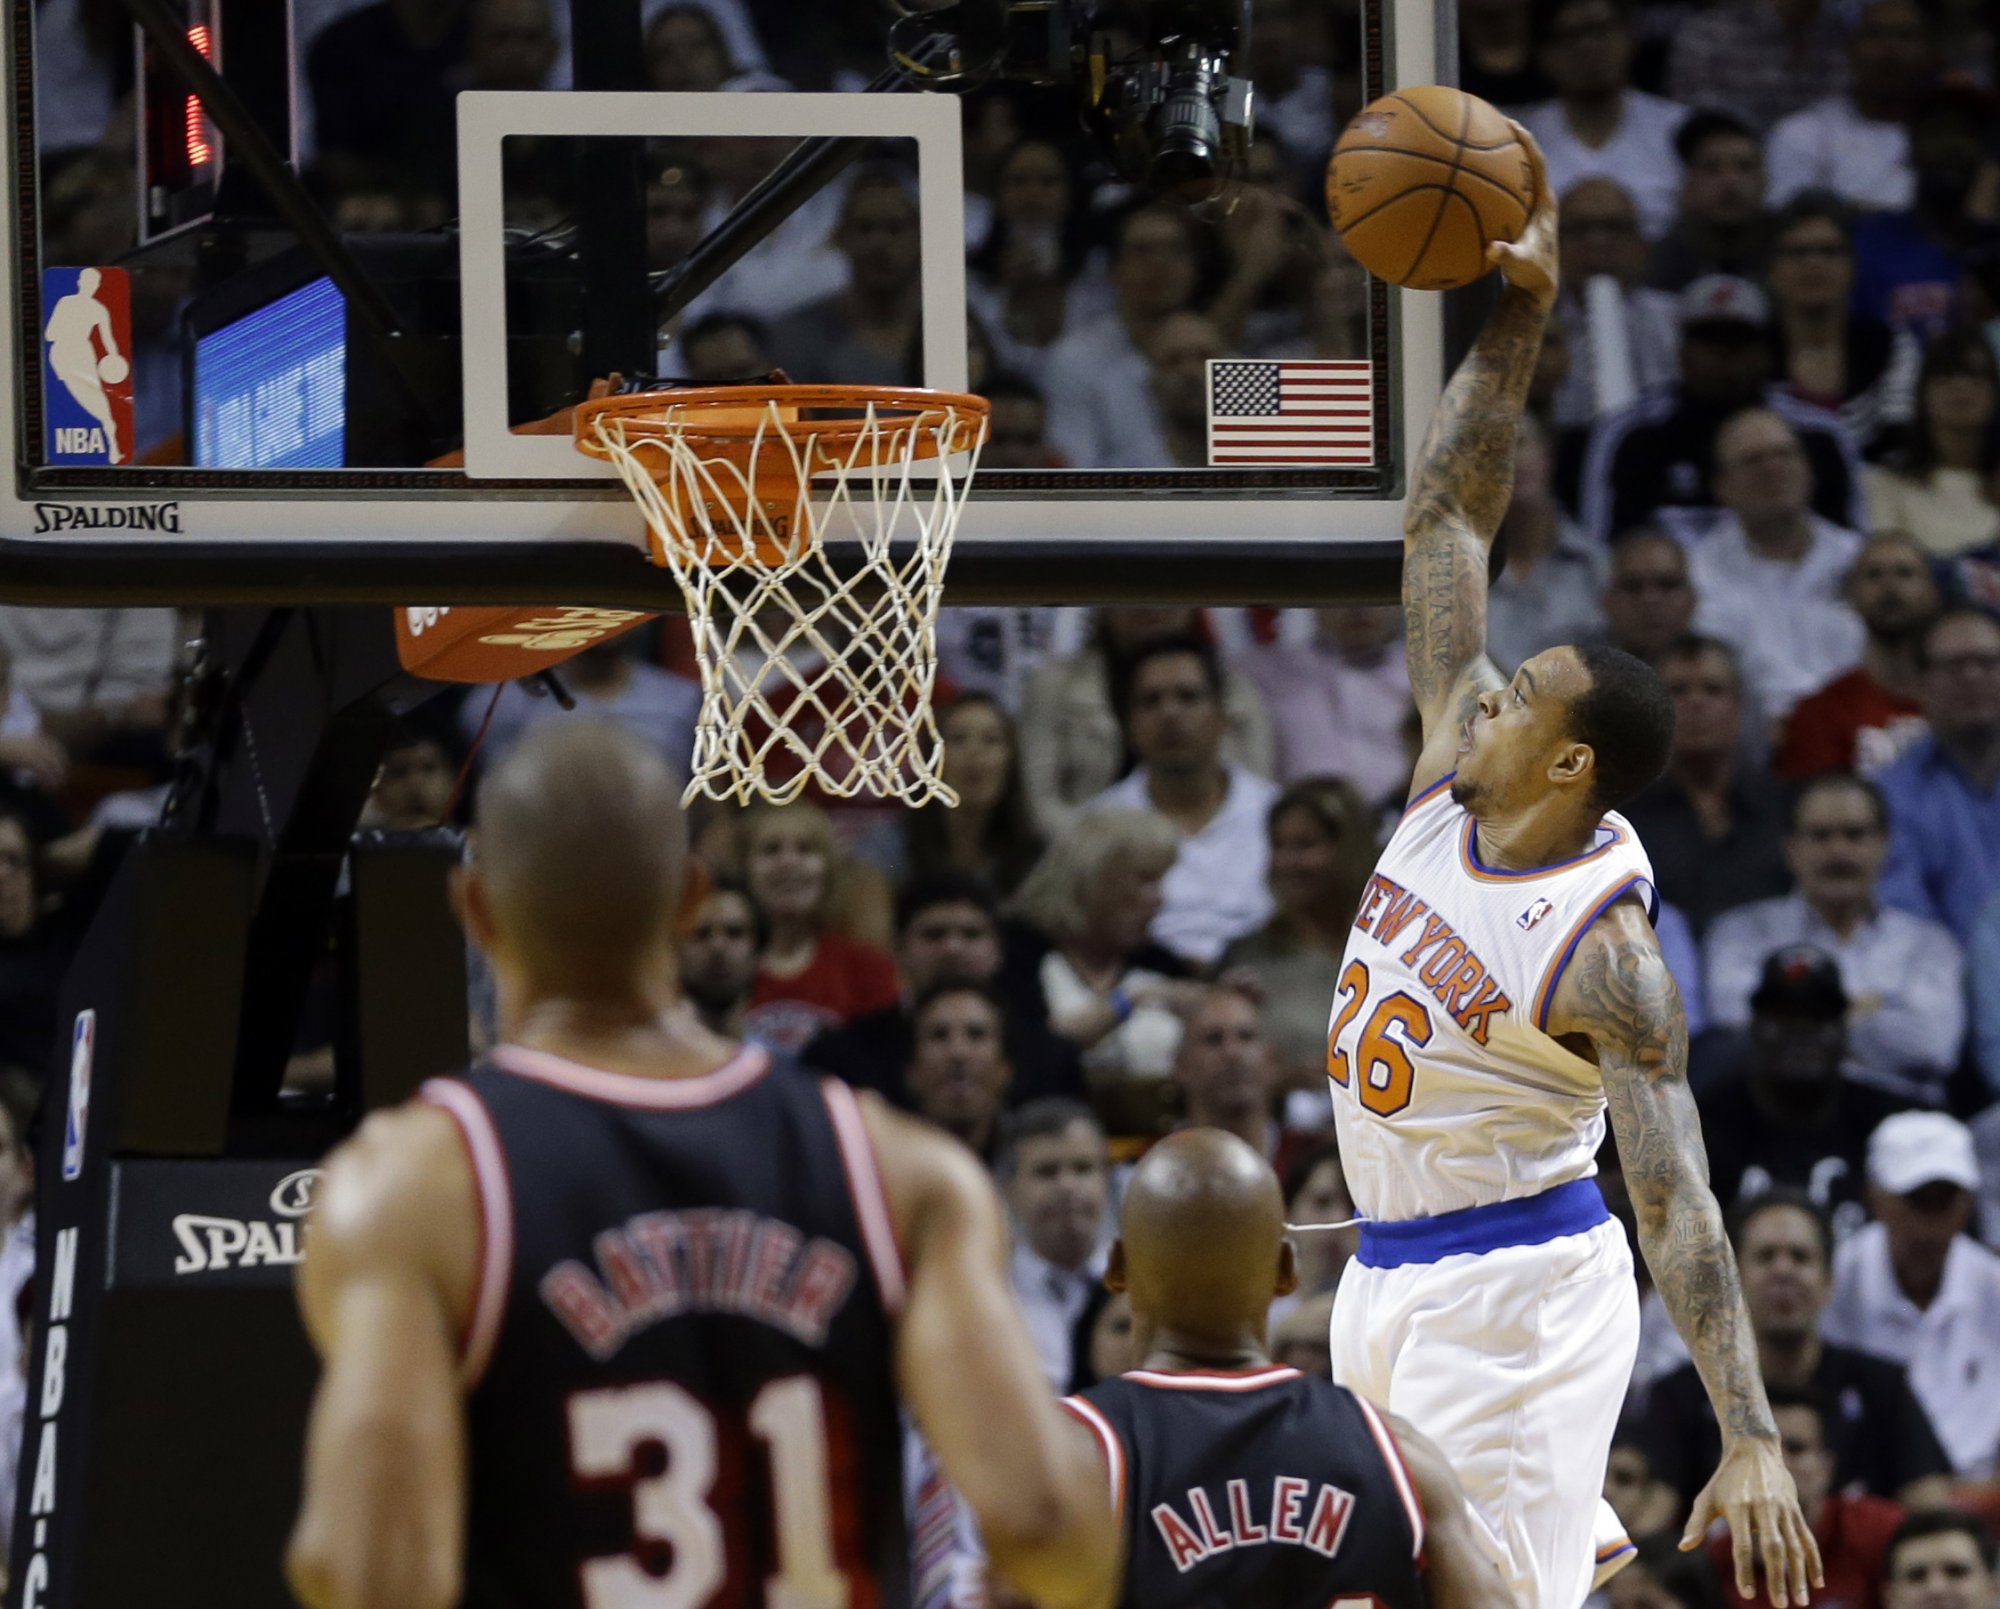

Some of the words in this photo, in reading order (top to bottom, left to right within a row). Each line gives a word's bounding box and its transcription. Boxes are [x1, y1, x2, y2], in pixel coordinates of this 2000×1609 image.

[55, 427, 106, 454] NBA
[34, 502, 184, 534] SPALDING
[690, 514, 789, 540] SALNG
[1400, 912, 1513, 1046] YORK
[1327, 957, 1434, 1118] 26
[172, 1213, 307, 1275] SPAL
[538, 1206, 858, 1362] BATTIER
[568, 1375, 852, 1609] 31
[1151, 1475, 1356, 1574] ALLEN
